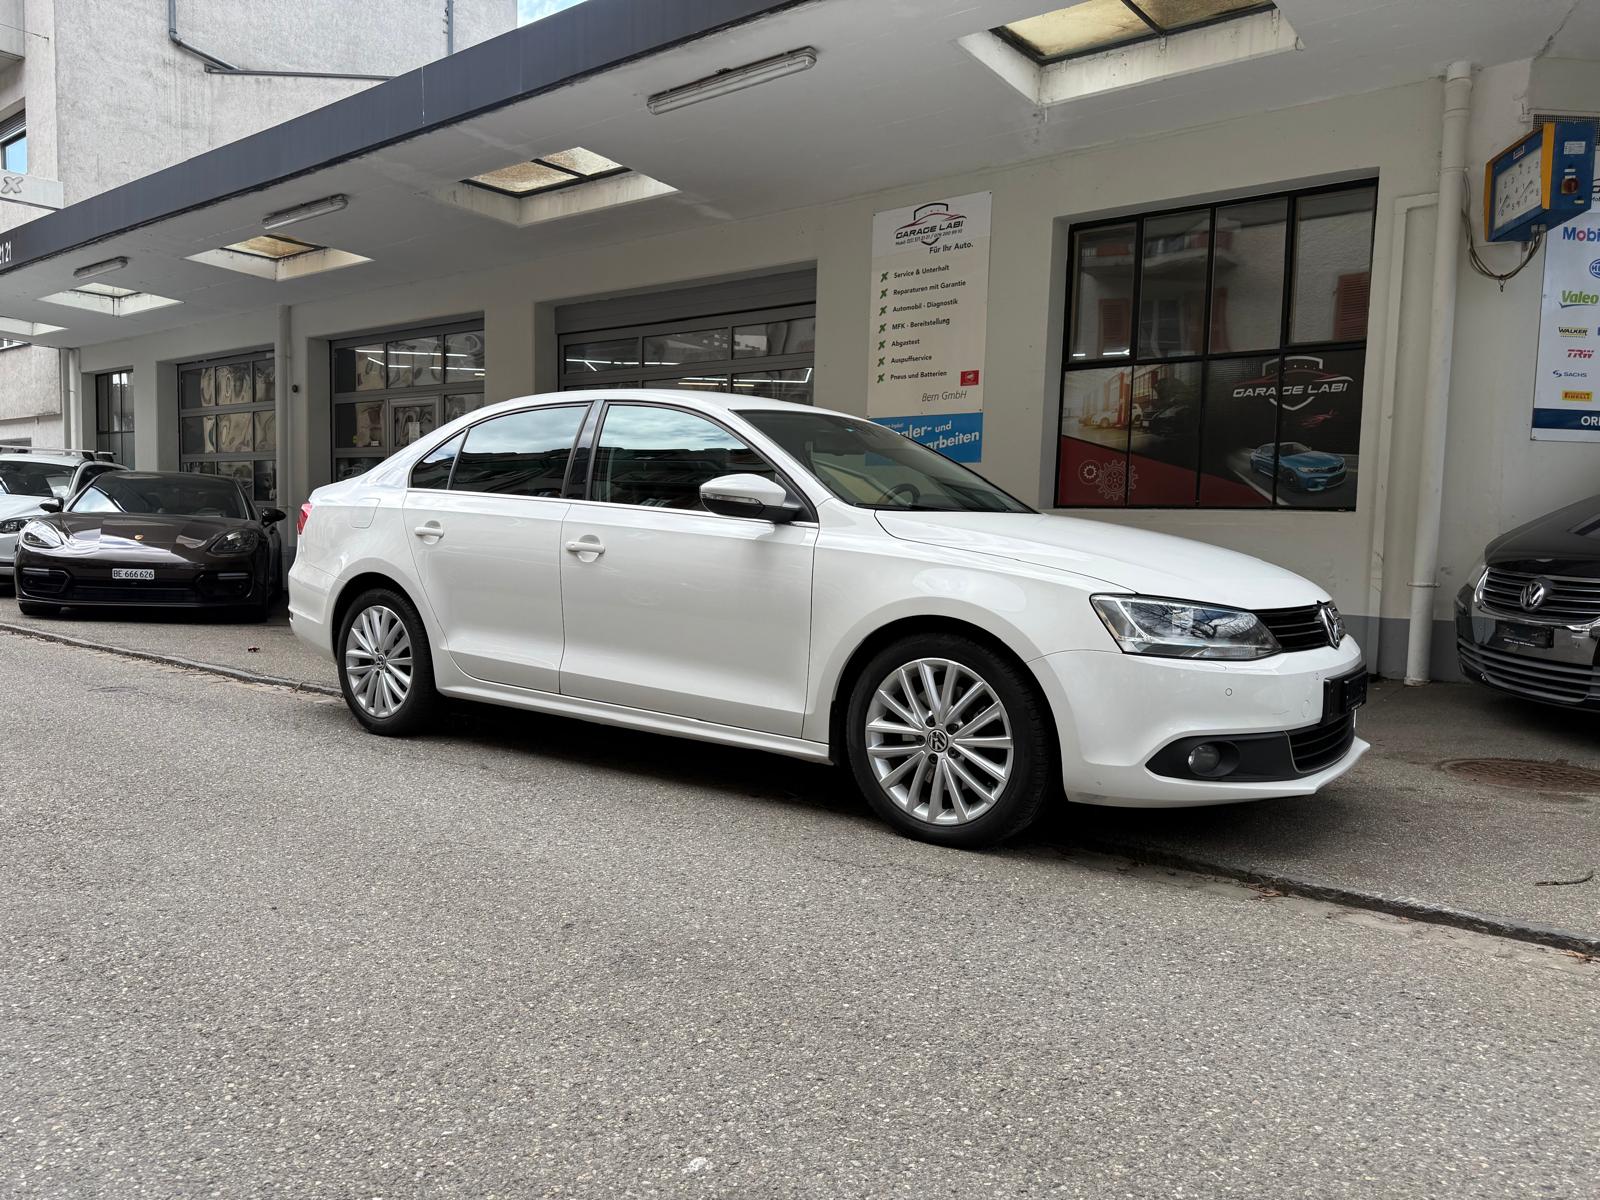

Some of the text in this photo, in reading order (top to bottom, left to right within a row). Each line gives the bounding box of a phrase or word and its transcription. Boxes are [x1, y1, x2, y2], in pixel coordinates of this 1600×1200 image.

[896, 225, 937, 239] GARAGE
[939, 221, 963, 231] LABI
[929, 241, 974, 254] Für Ihr Auto.
[894, 270, 914, 279] Service
[922, 264, 950, 274] Unterhalt
[893, 280, 967, 296] Reparaturen mit Garantie
[1562, 290, 1600, 304] Valeo
[893, 303, 922, 313] Automobil
[927, 298, 958, 309] Diagnostik
[910, 318, 950, 328] Bereitstellung
[1558, 327, 1588, 336] WALKER
[891, 339, 920, 347] Abgastest
[891, 355, 932, 364] Auspuffservice
[1568, 349, 1594, 359] TRW
[920, 370, 948, 378] Batterien
[1307, 383, 1348, 394] LABI
[922, 390, 967, 402] Bern GmbH
[935, 420, 952, 432] und
[125, 570, 138, 578] 666
